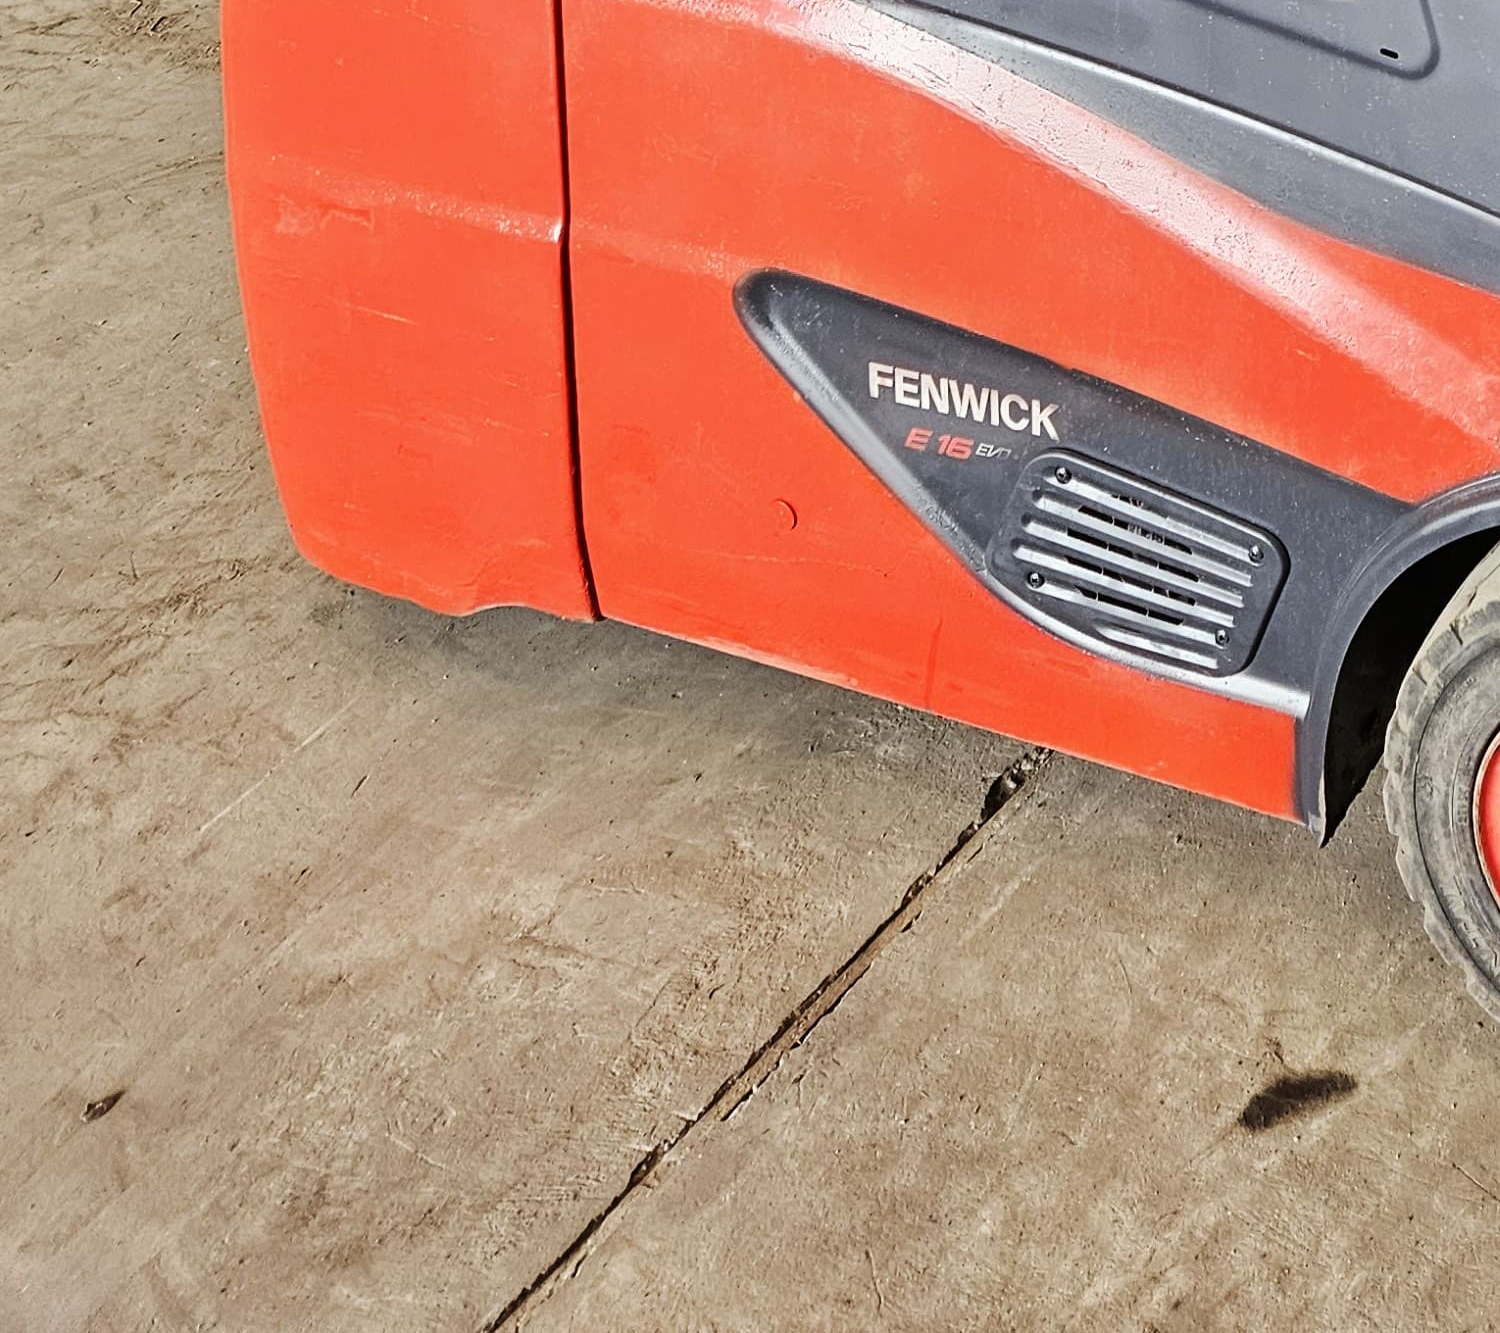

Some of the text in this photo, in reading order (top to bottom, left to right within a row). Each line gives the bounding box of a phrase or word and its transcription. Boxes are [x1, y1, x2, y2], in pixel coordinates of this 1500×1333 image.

[868, 361, 1061, 442] FENWICK
[904, 427, 933, 451] E
[937, 434, 974, 460] 16
